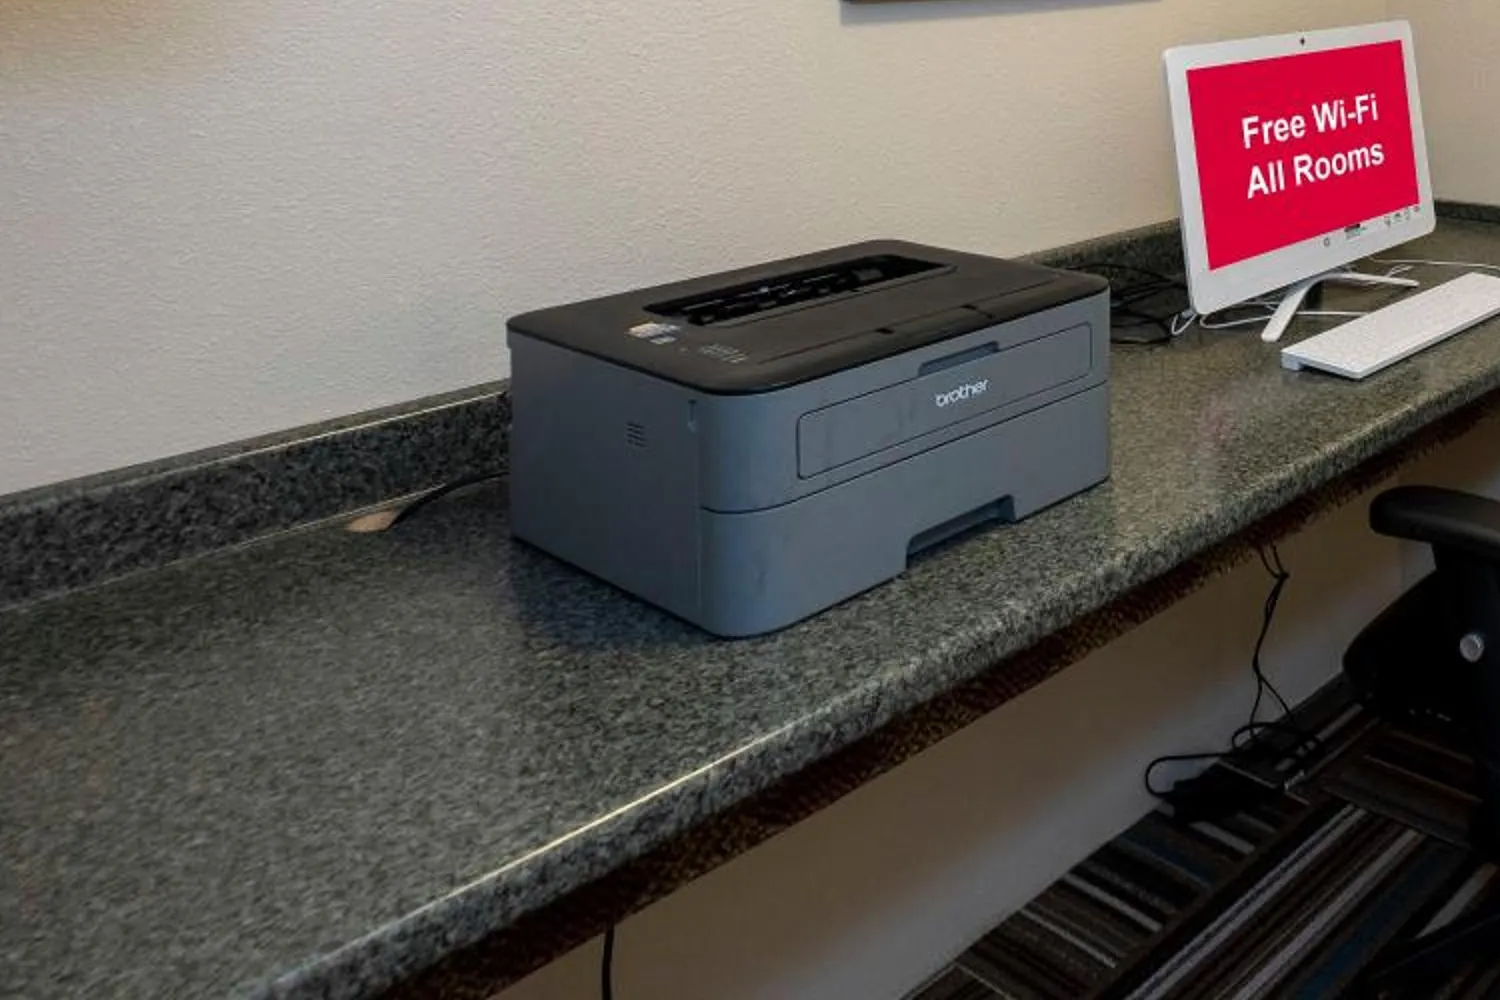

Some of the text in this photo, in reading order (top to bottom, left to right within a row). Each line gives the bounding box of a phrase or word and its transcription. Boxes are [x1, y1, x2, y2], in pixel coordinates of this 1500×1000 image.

[1242, 93, 1378, 149] Free Wi-Fi
[1247, 143, 1385, 199] All Rooms
[935, 378, 990, 408] brother
